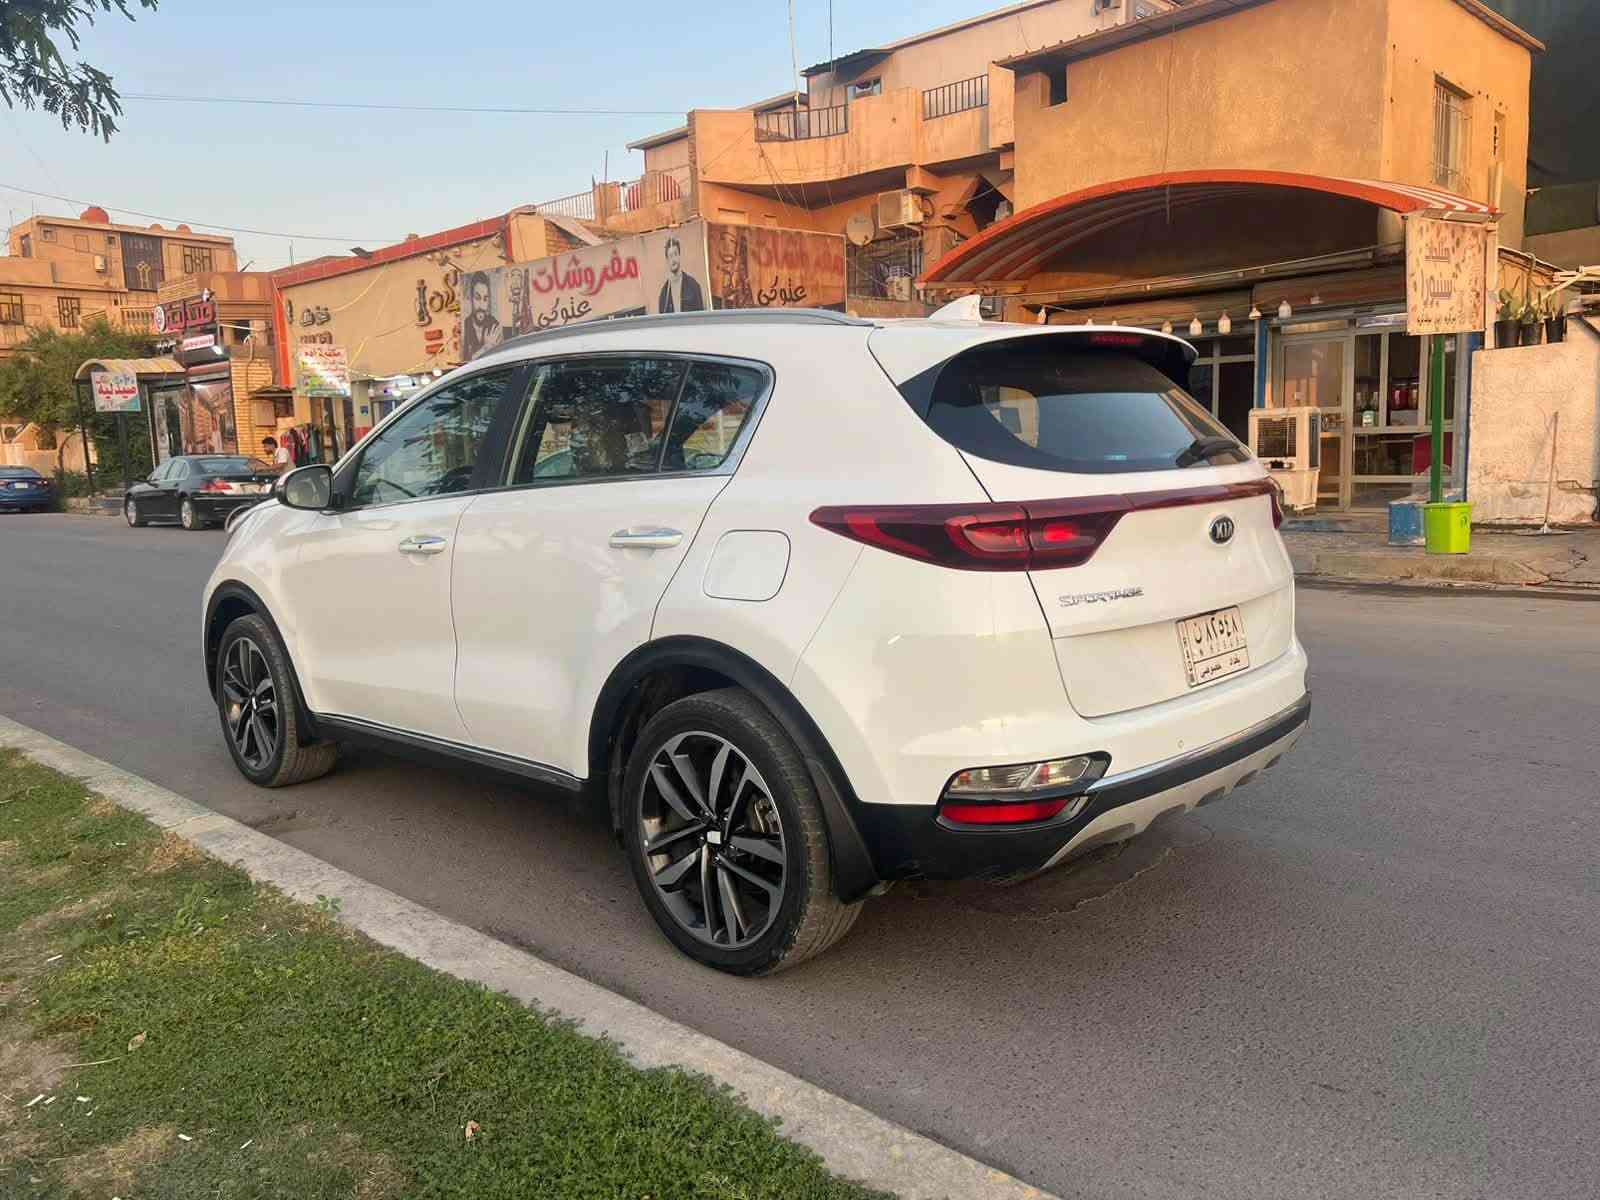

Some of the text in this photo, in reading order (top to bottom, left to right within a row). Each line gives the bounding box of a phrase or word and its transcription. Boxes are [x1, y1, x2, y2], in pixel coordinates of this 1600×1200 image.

[531, 247, 639, 296] مفروشات
[1215, 521, 1234, 539] KIA
[1059, 586, 1144, 608] SPORTAGE
